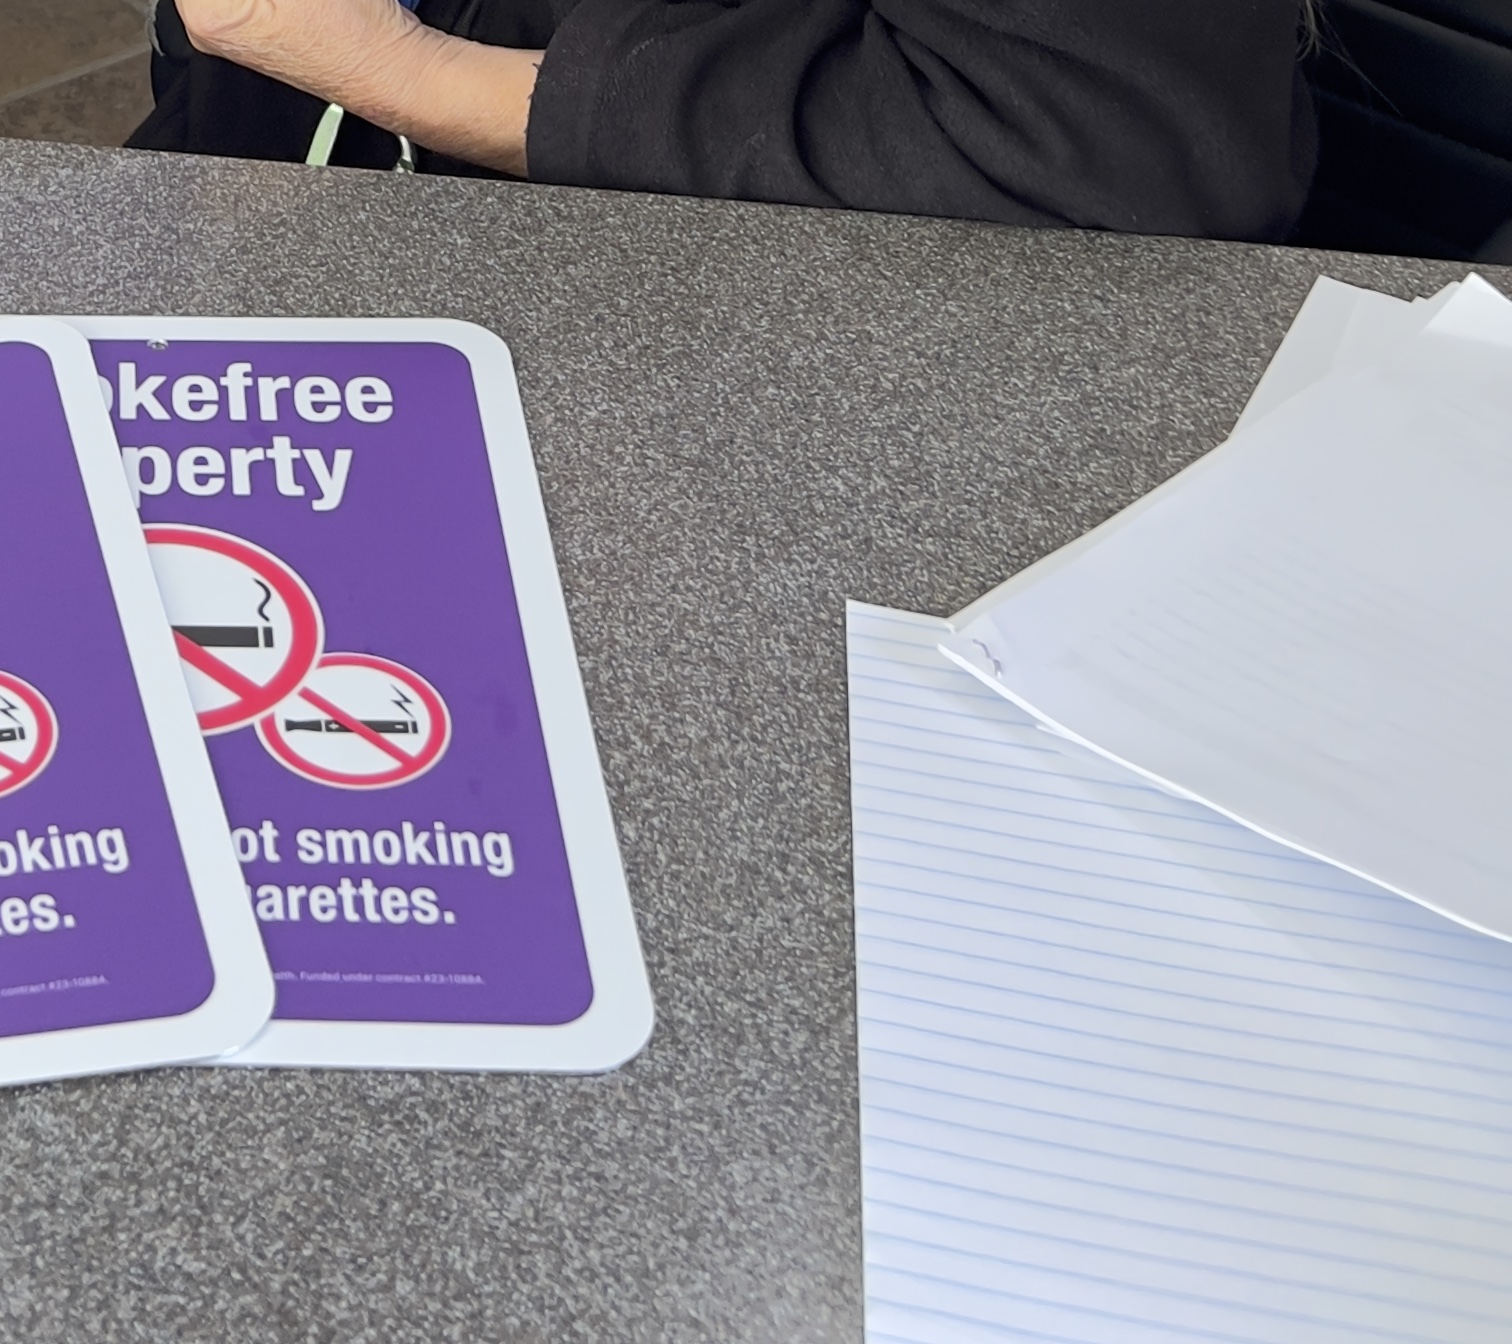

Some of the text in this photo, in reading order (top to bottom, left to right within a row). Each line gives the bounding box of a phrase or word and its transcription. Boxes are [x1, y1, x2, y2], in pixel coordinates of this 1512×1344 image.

[122, 437, 353, 511] perty
[232, 820, 514, 877] ot smoking
[245, 878, 455, 924] arettes.
